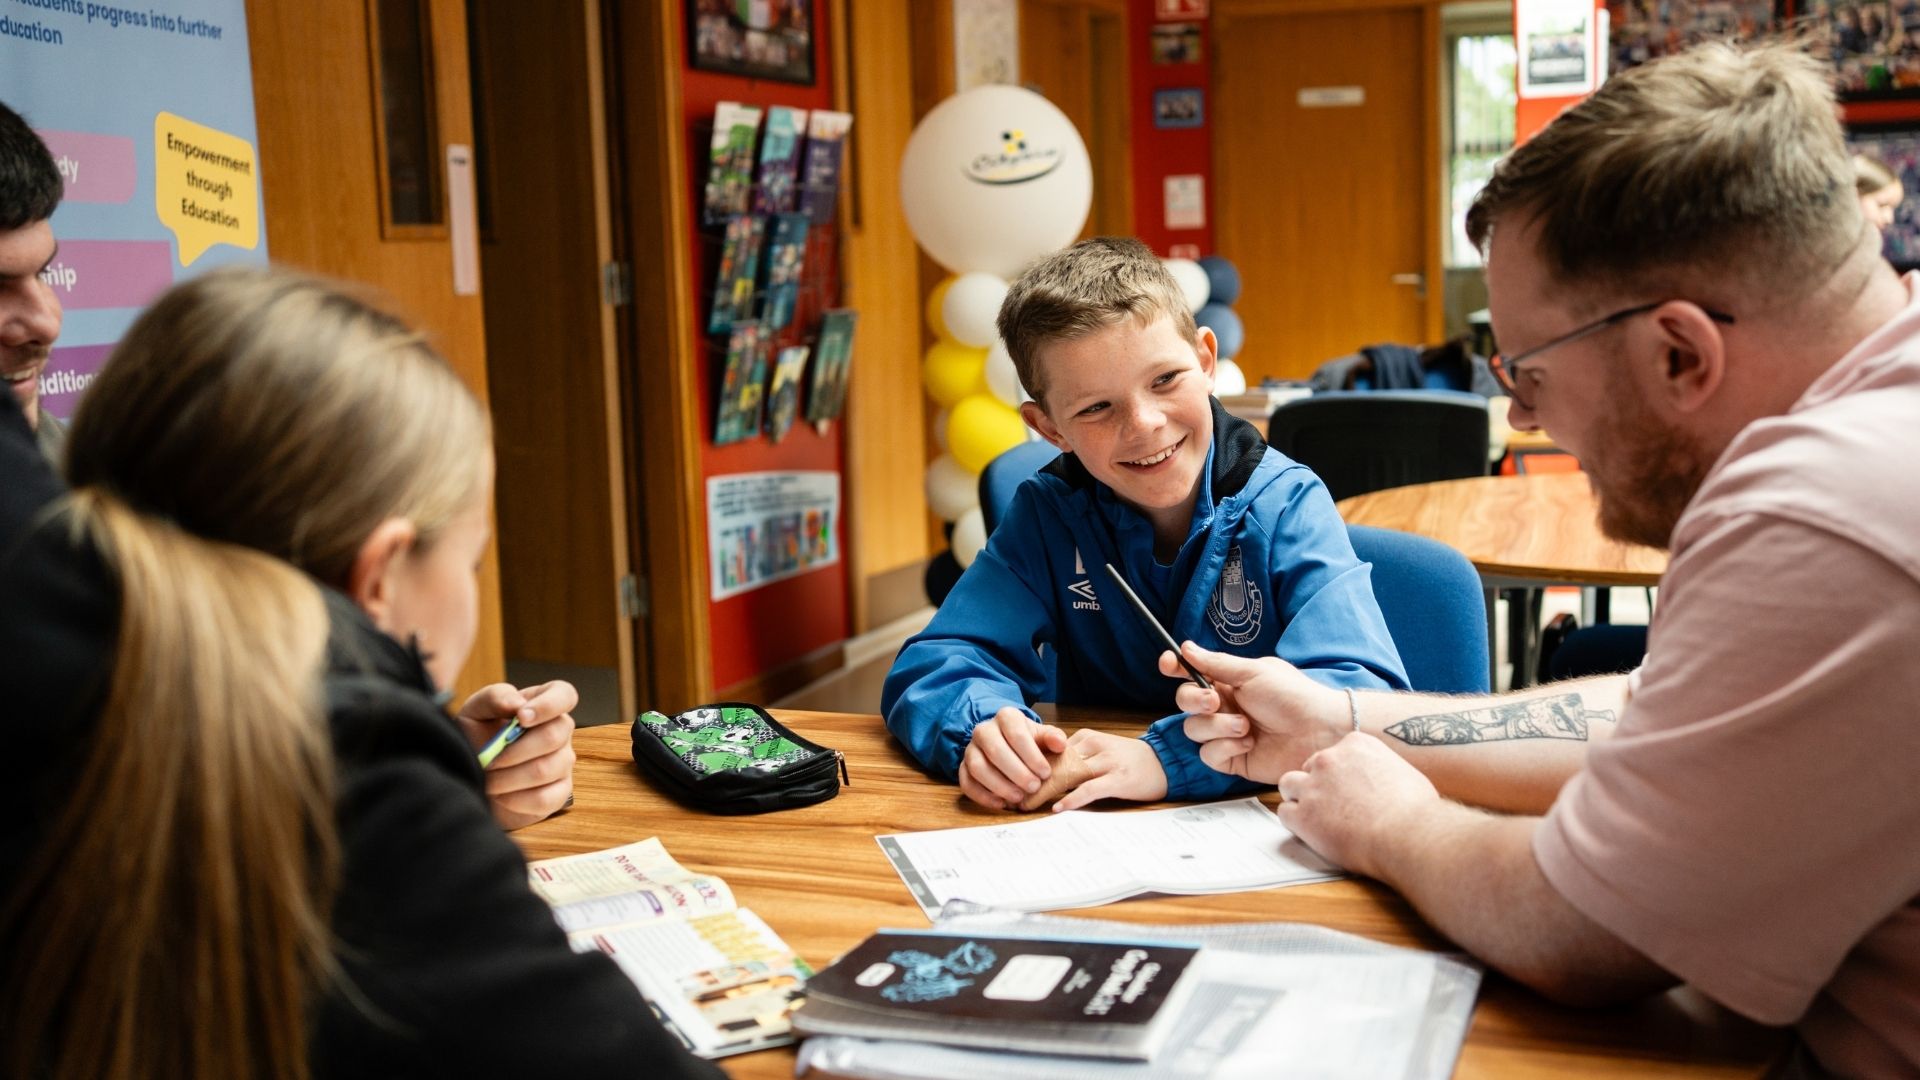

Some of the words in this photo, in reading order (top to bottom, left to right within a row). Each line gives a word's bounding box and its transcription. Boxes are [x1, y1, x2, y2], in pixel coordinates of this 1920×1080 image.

[0, 16, 63, 45] ducation
[87, 3, 148, 27] progress
[150, 10, 175, 32] into
[177, 16, 222, 40] further
[167, 132, 250, 176] Empowerment
[57, 155, 79, 184] dy
[186, 170, 233, 202] through
[181, 198, 239, 230] Education
[40, 262, 77, 292] hip
[1073, 600, 1101, 611] umb
[1229, 633, 1252, 643] CELTIC
